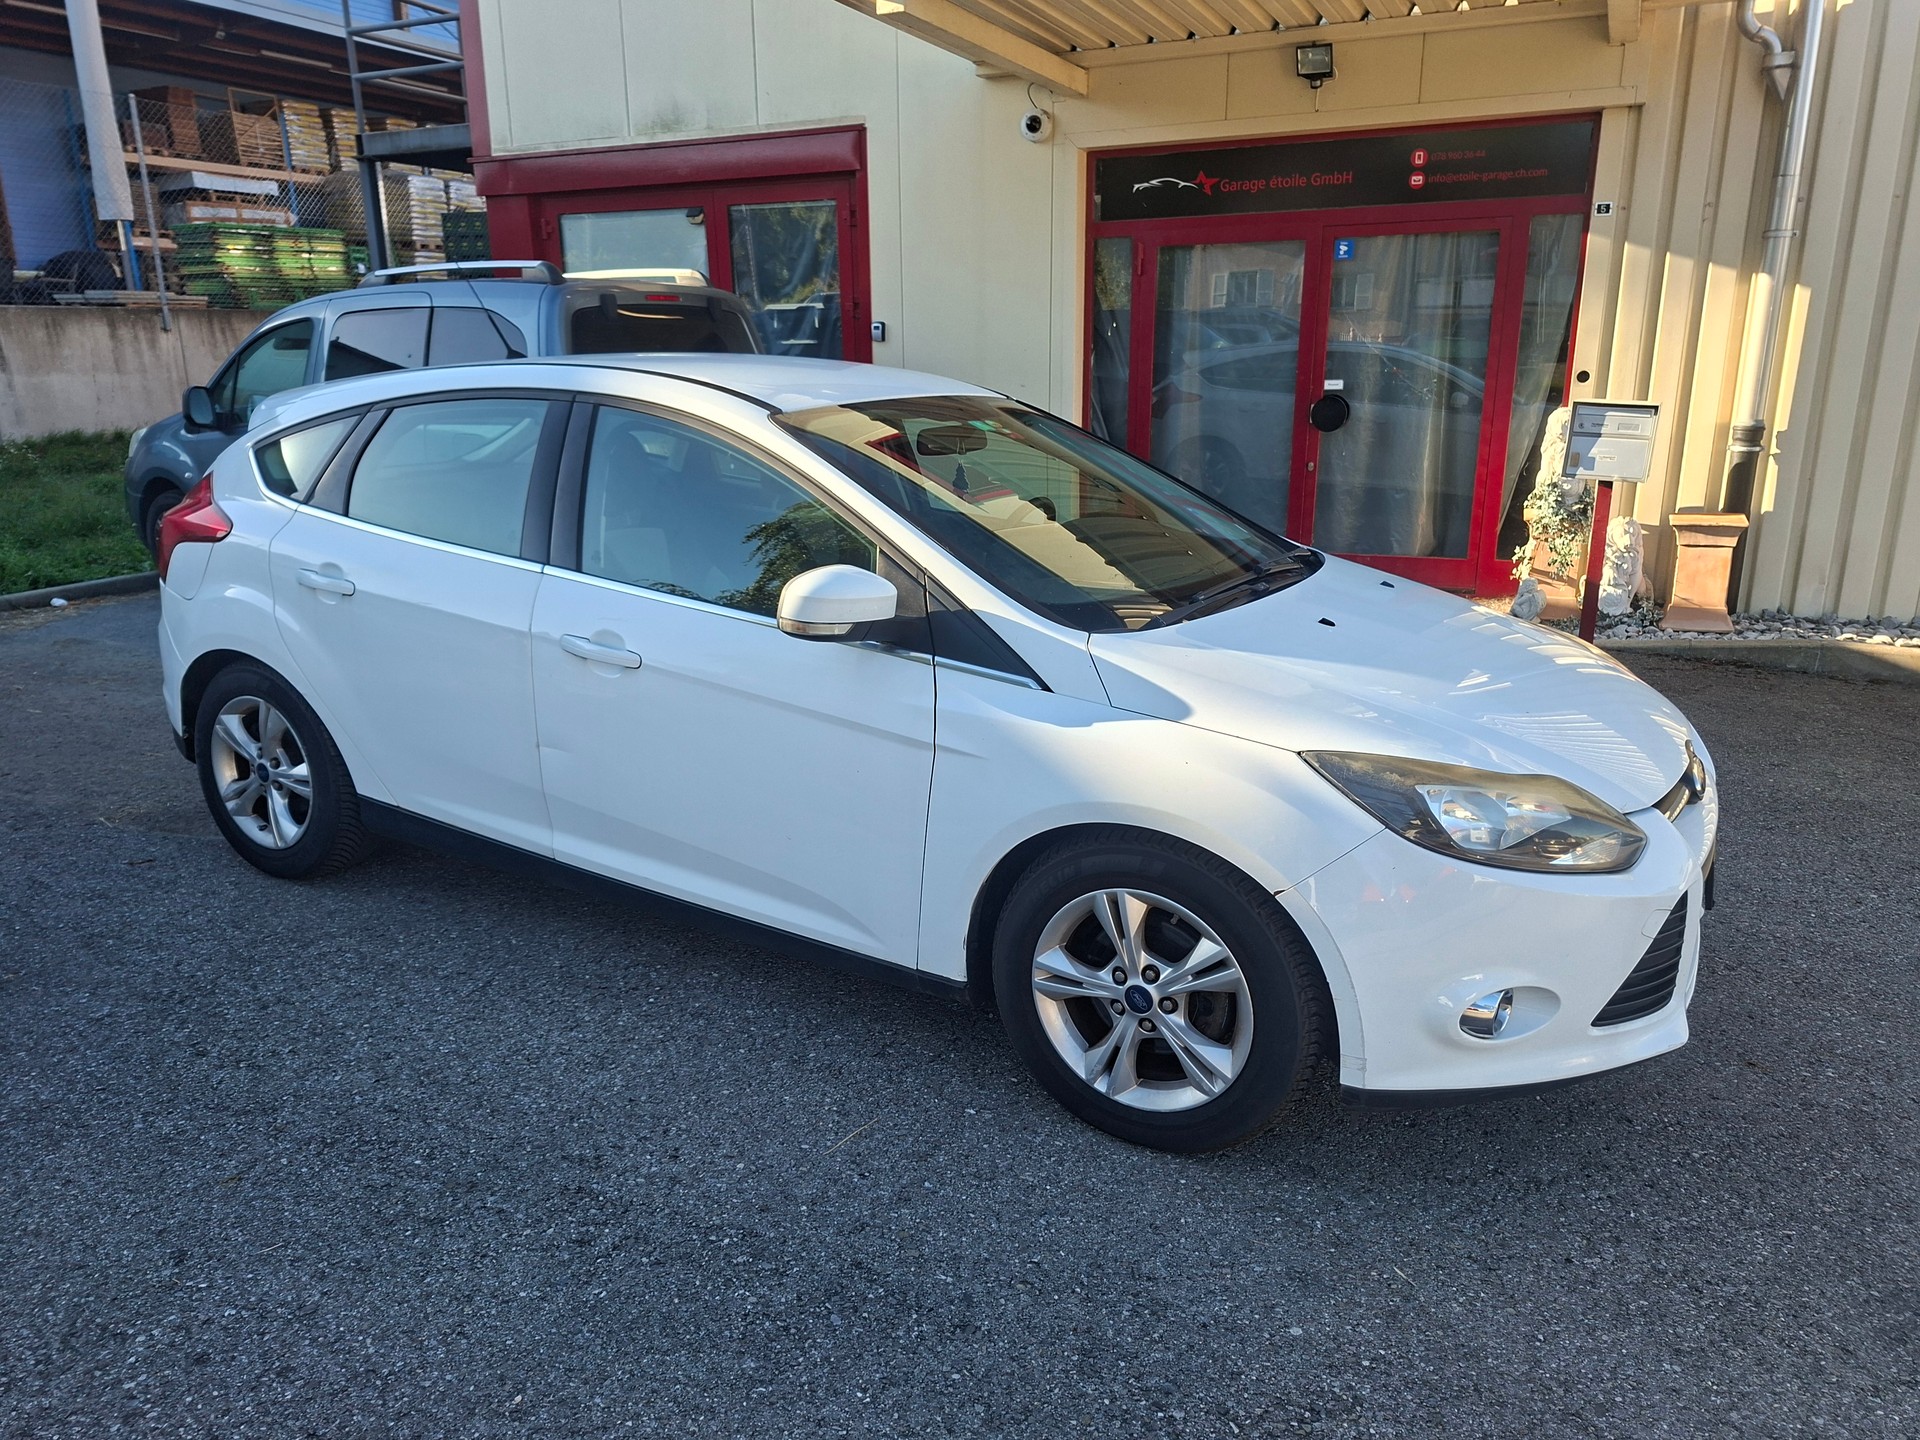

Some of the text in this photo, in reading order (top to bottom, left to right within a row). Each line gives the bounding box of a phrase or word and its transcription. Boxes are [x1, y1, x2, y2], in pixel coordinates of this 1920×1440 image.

[1220, 171, 1353, 193] Garage étoile GmbH
[1428, 168, 1548, 183] info@etoile-garage.ch.com
[1600, 205, 1606, 214] 5
